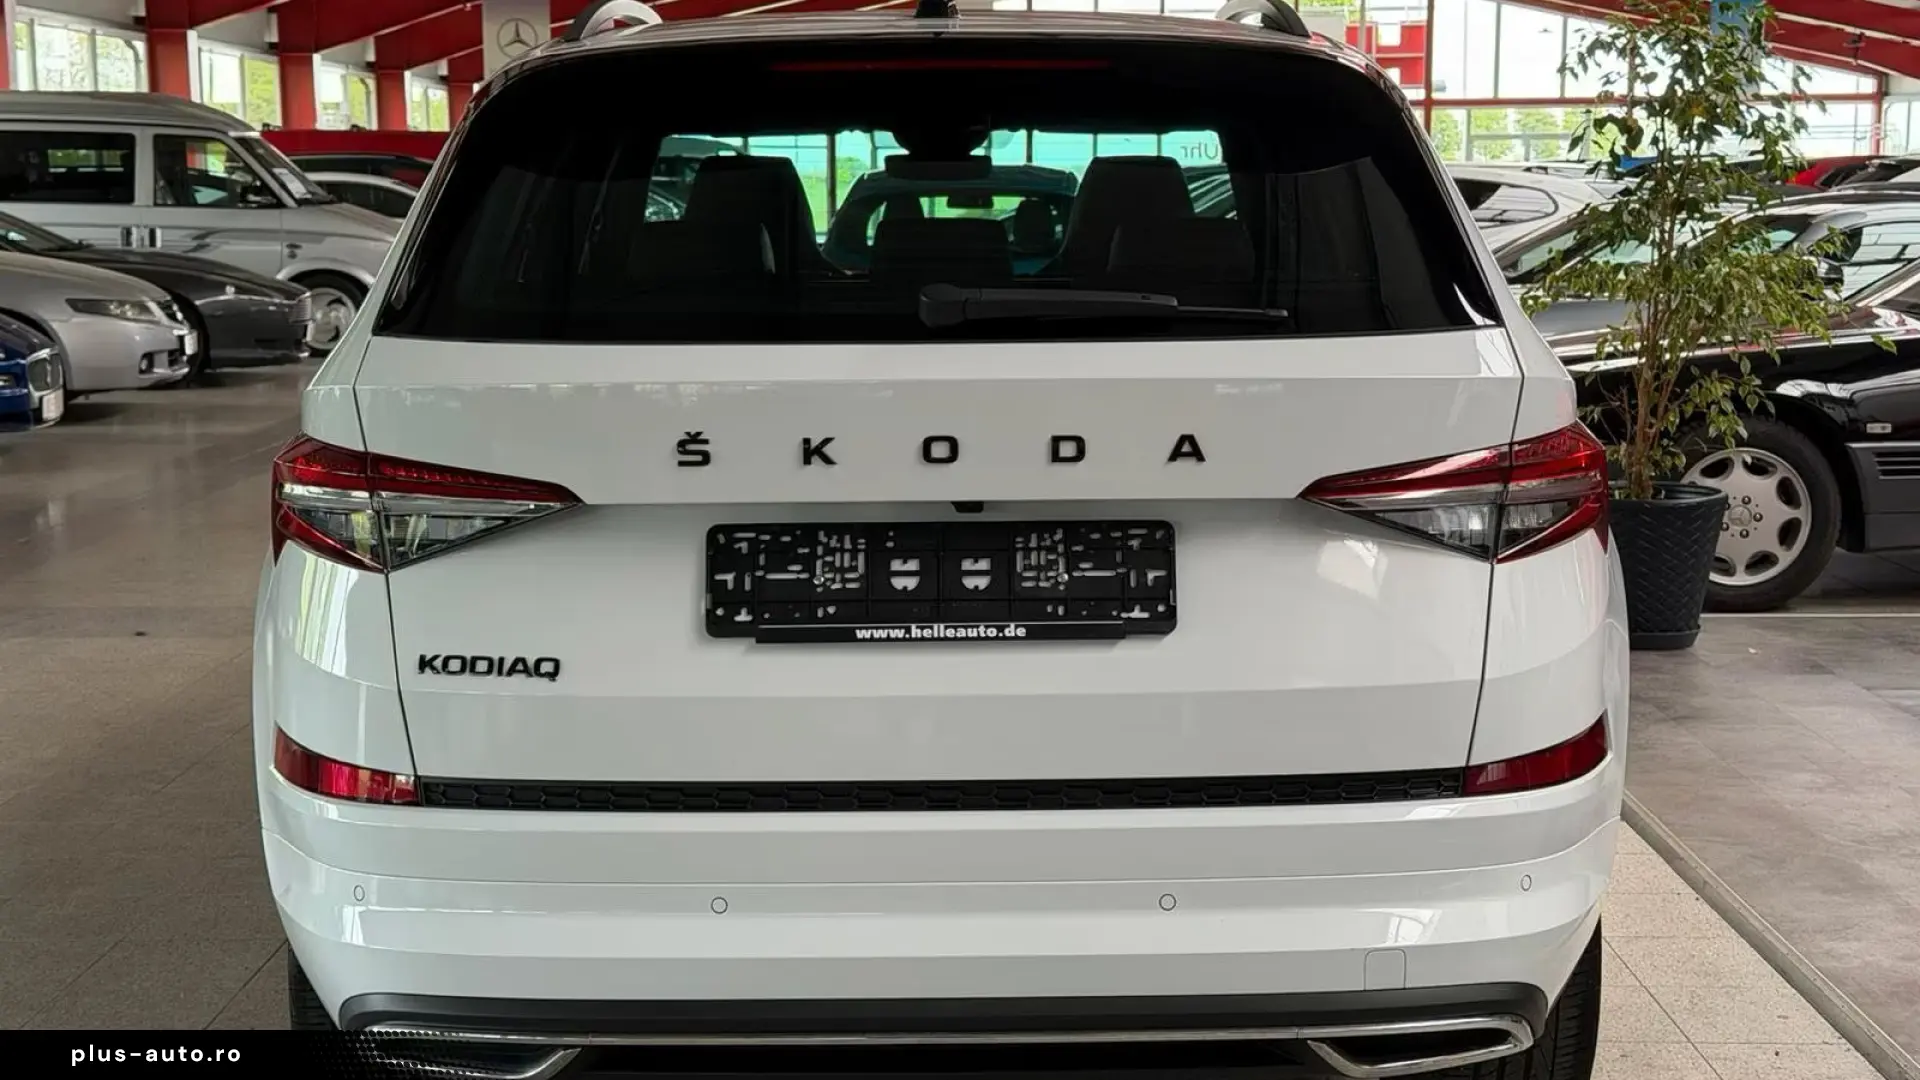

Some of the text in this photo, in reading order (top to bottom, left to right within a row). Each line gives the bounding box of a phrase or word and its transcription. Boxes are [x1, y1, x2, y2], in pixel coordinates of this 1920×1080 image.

[676, 431, 1207, 467] ŠKODA
[855, 624, 1027, 639] www.helleauto.de
[418, 654, 561, 682] KODIAQ
